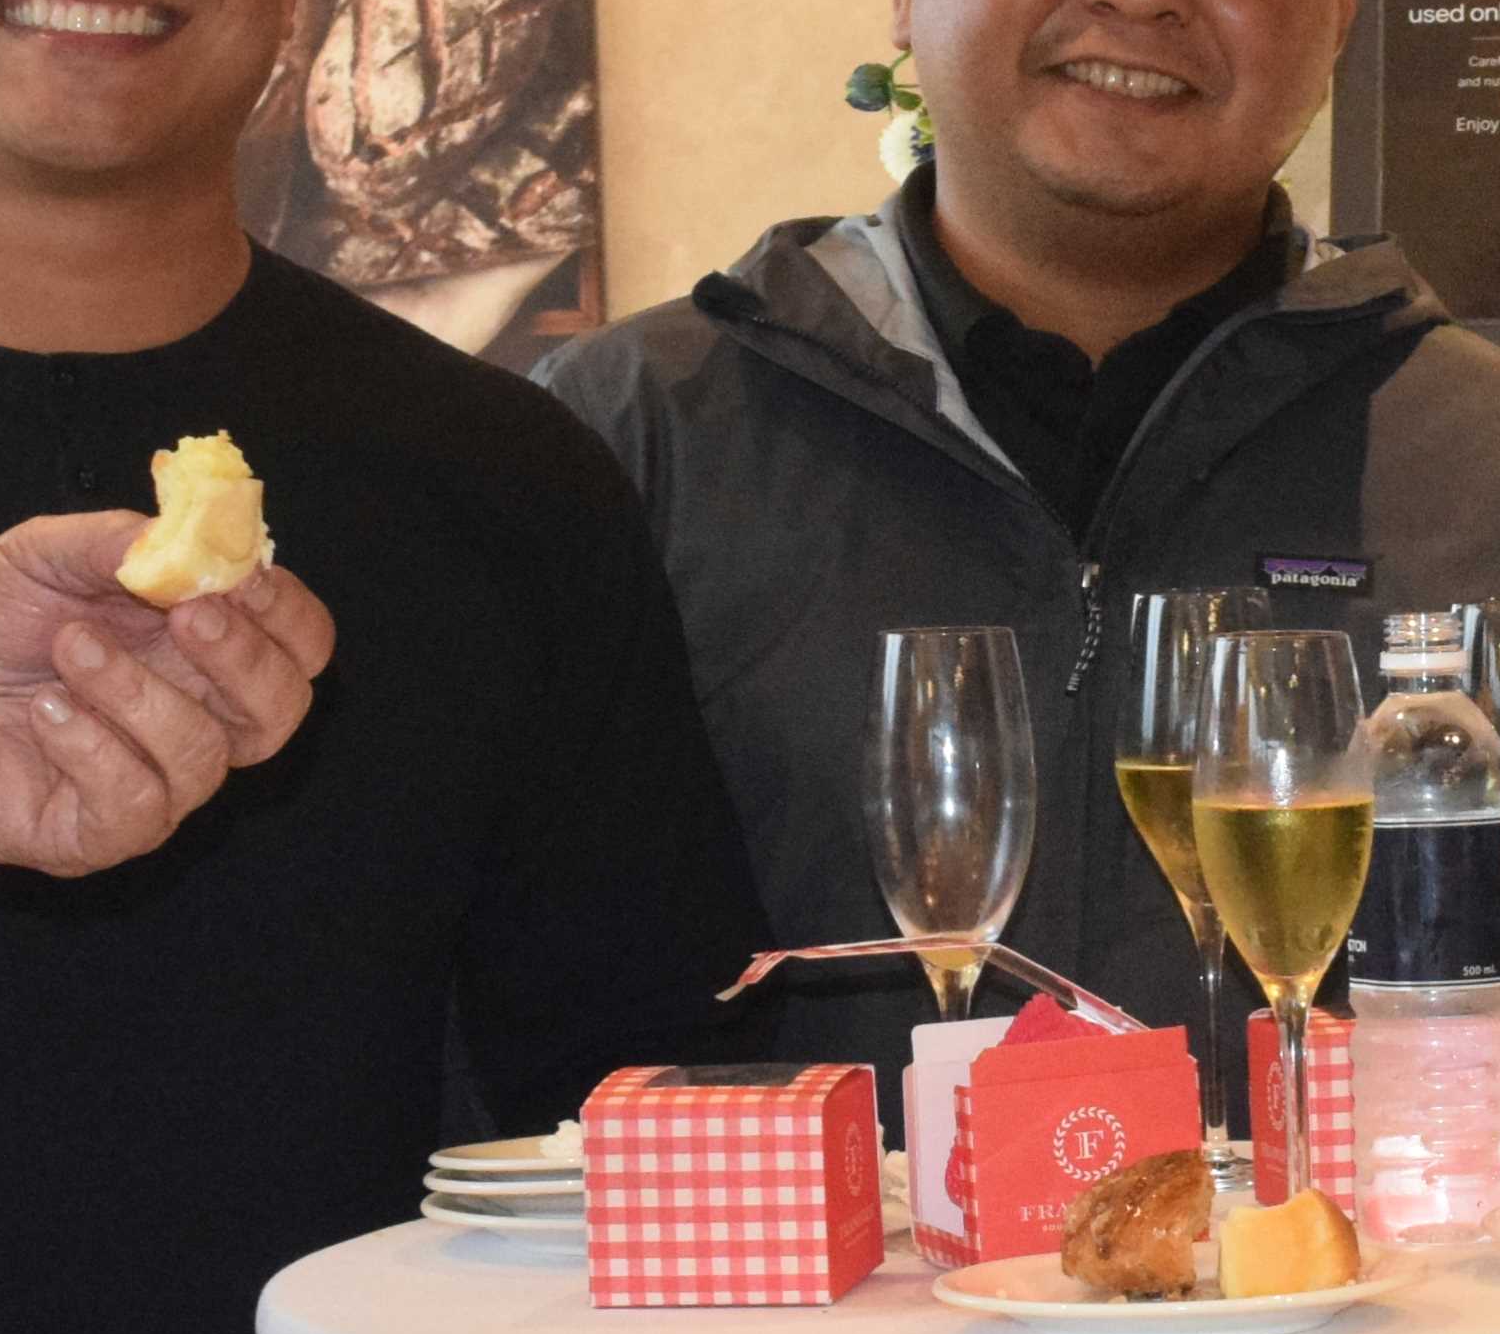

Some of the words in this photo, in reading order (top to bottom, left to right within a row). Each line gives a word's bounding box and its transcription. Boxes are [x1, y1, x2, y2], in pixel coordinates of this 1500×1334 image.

[1408, 4, 1465, 24] used
[1457, 75, 1481, 88] and
[1456, 116, 1499, 134] Enjoy
[1271, 572, 1357, 587] patagonia
[1020, 1202, 1068, 1222] FRA
